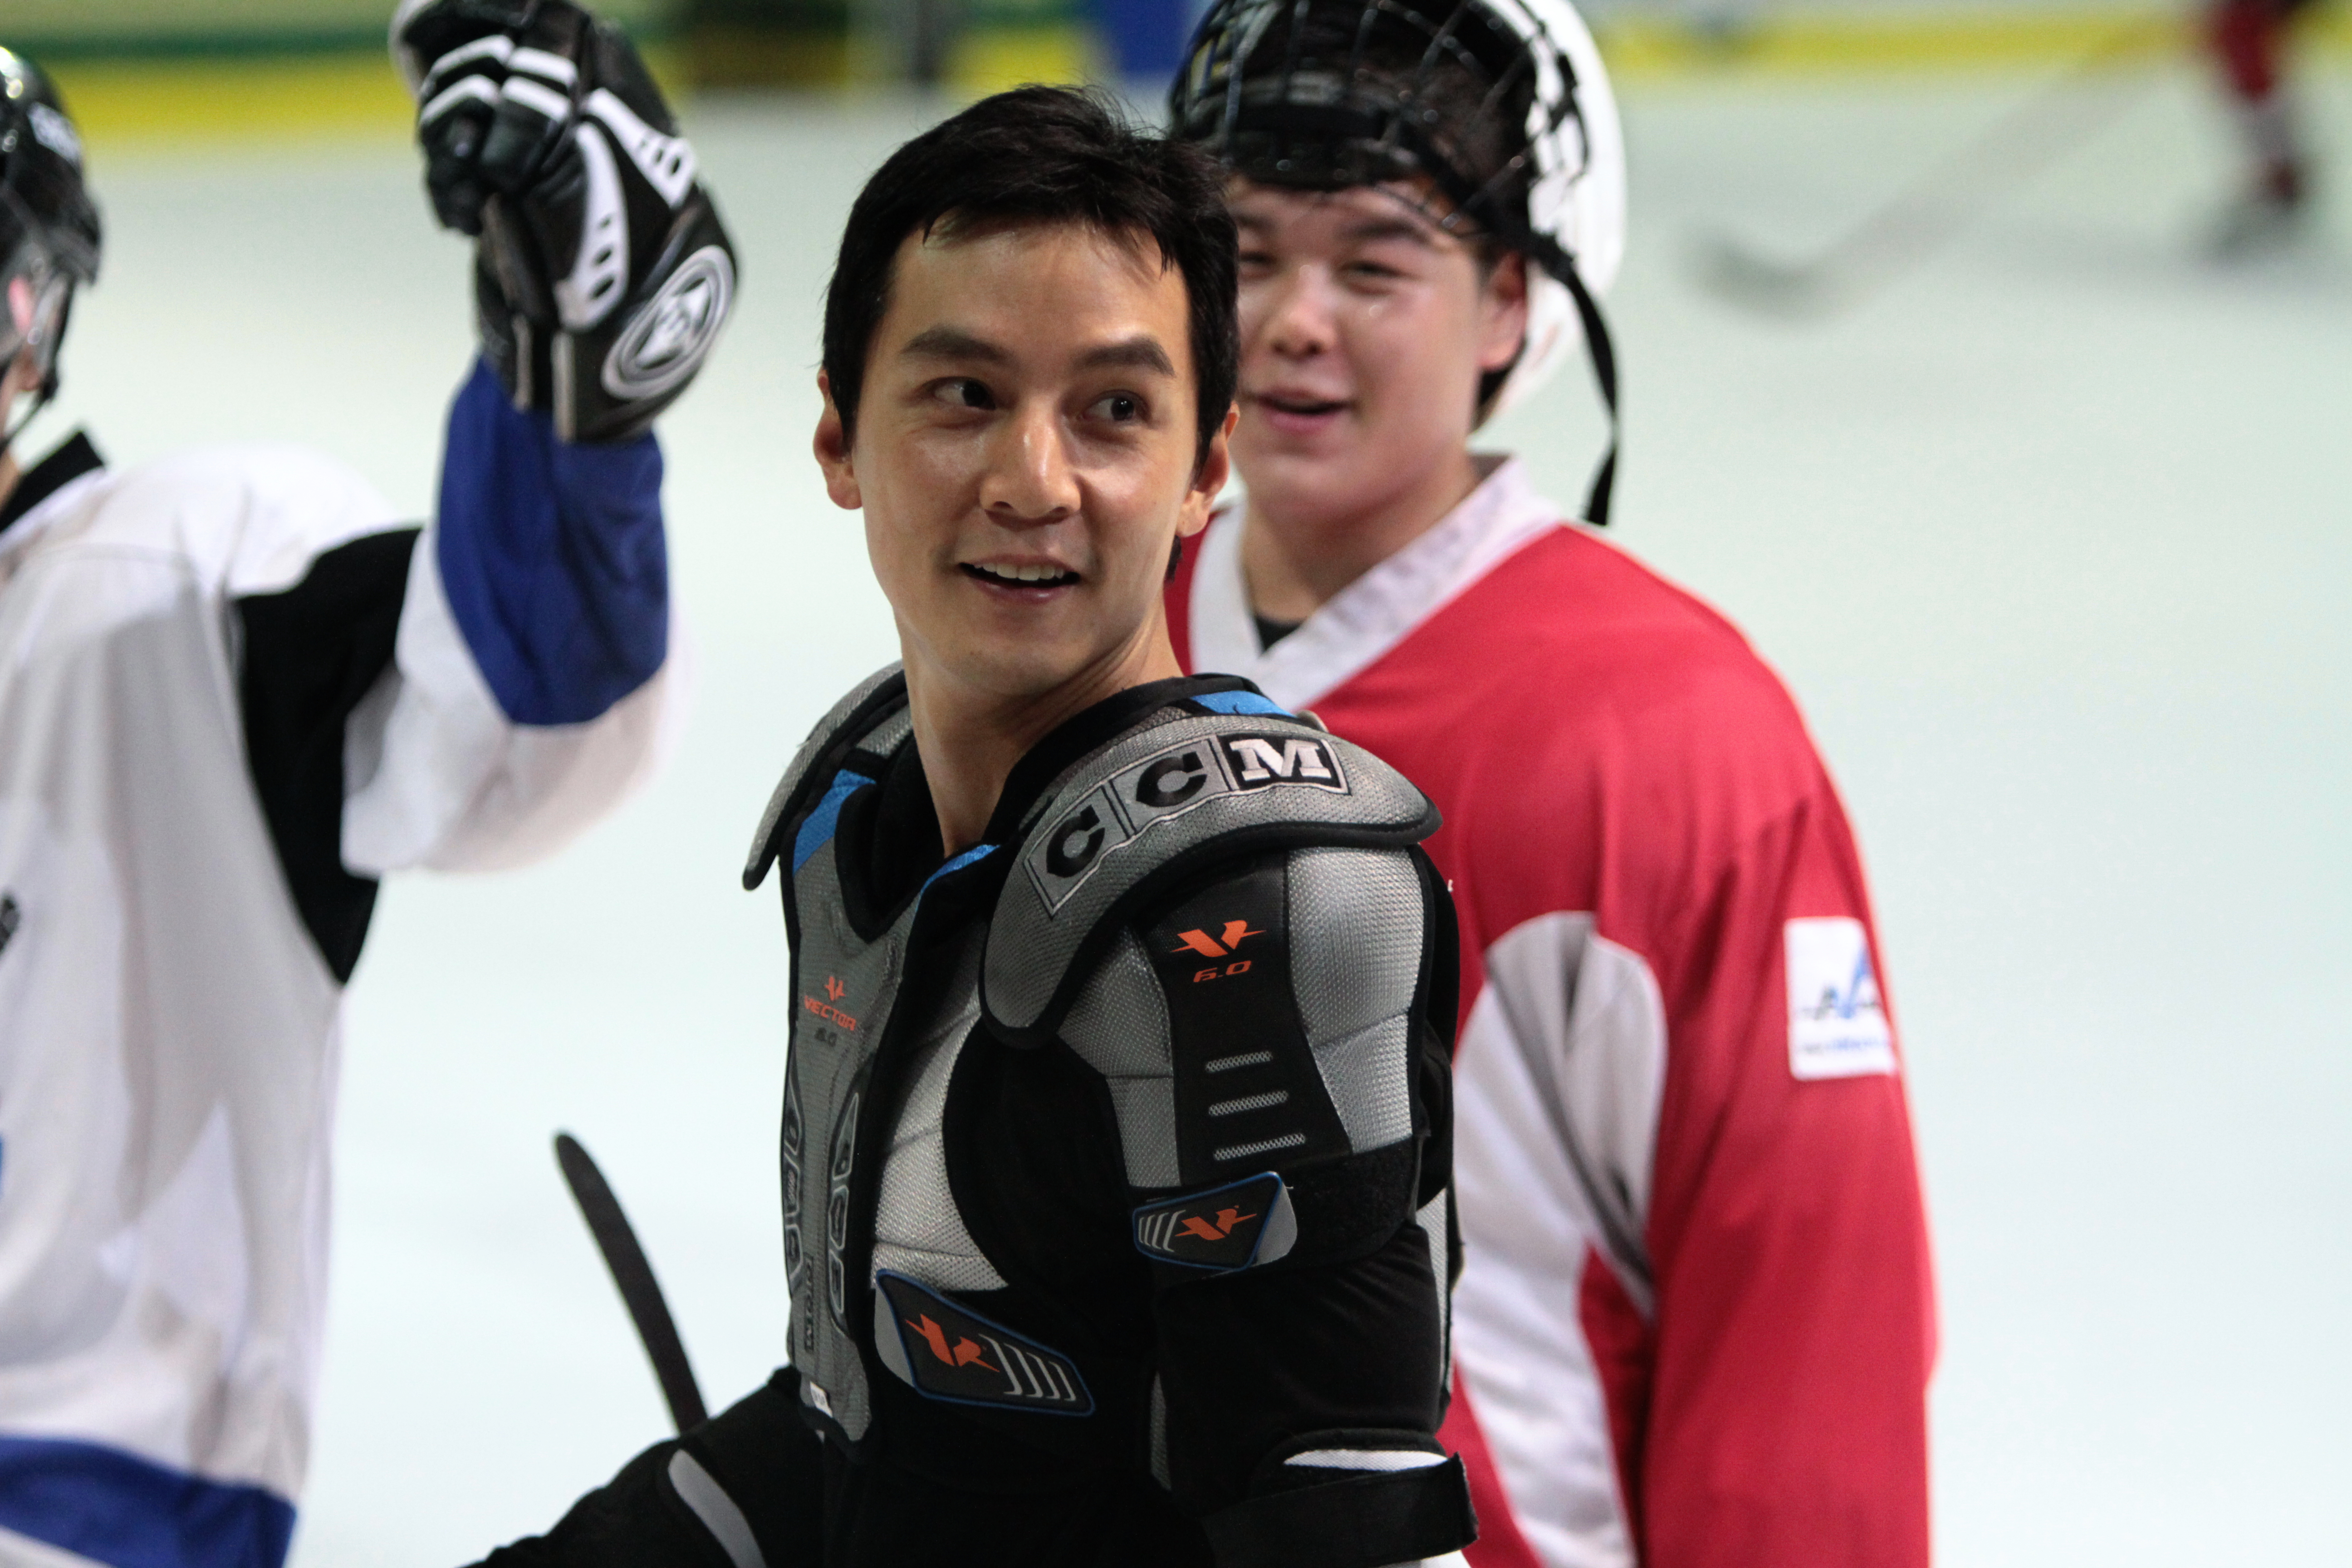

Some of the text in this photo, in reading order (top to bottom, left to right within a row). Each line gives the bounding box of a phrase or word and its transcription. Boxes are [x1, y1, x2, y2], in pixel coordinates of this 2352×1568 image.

[1046, 737, 1332, 878] CCM
[1192, 960, 1251, 983] 6.0
[804, 995, 857, 1031] VECTOR
